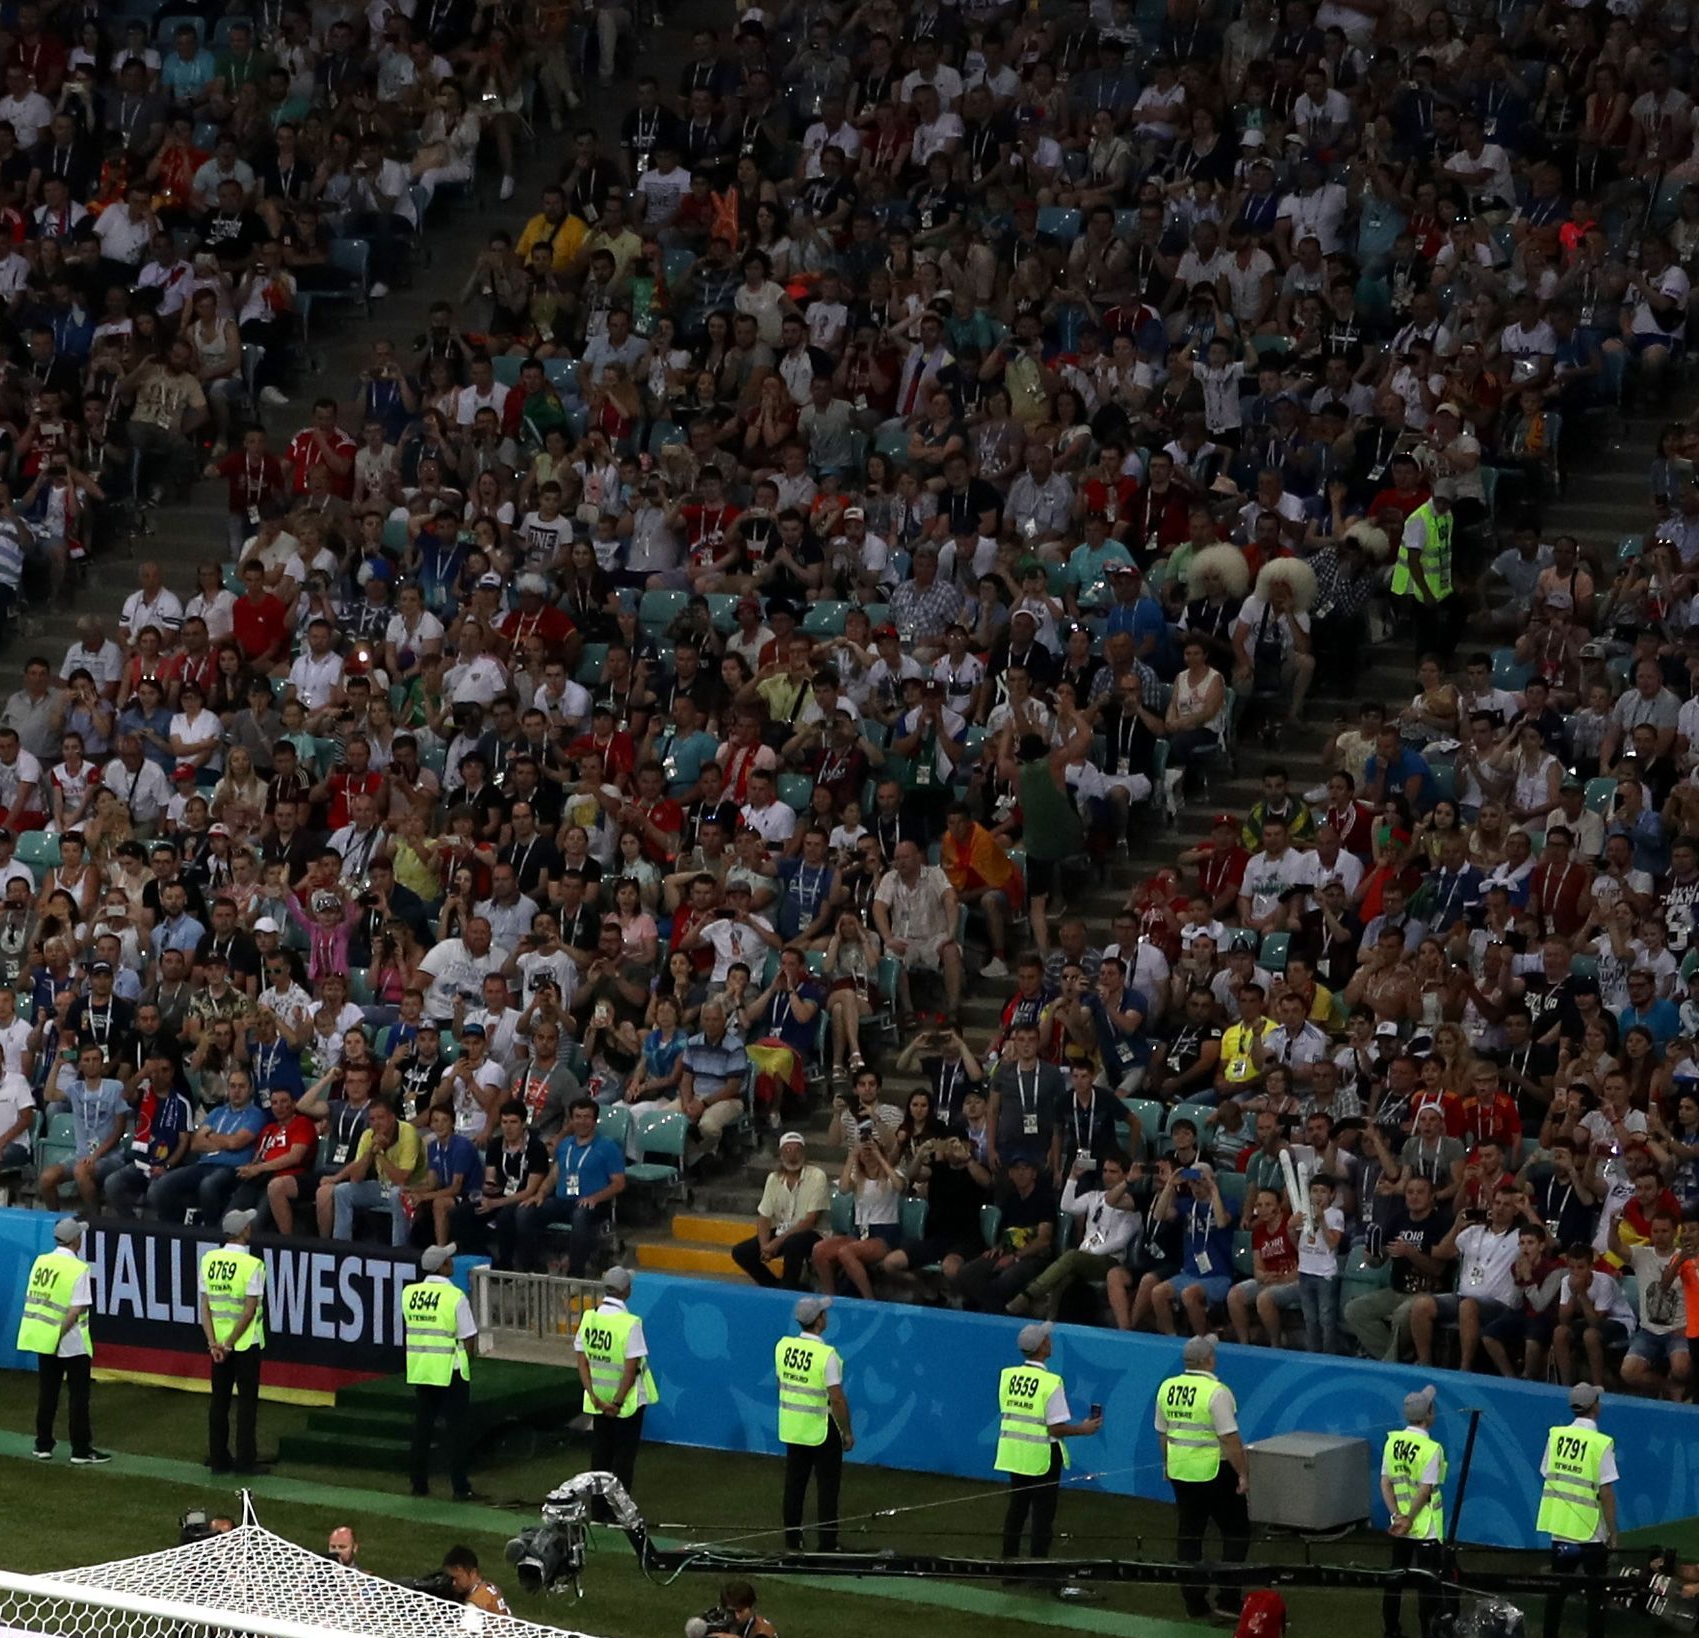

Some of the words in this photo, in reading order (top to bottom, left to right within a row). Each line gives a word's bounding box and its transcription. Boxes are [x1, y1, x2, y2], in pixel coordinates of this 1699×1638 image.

[208, 1261, 237, 1280] 8769
[409, 1291, 441, 1311] 8544
[783, 1347, 813, 1371] 8535
[1008, 1375, 1039, 1397] 8559
[1167, 1385, 1197, 1407] 8793
[1556, 1436, 1588, 1462] 8791
